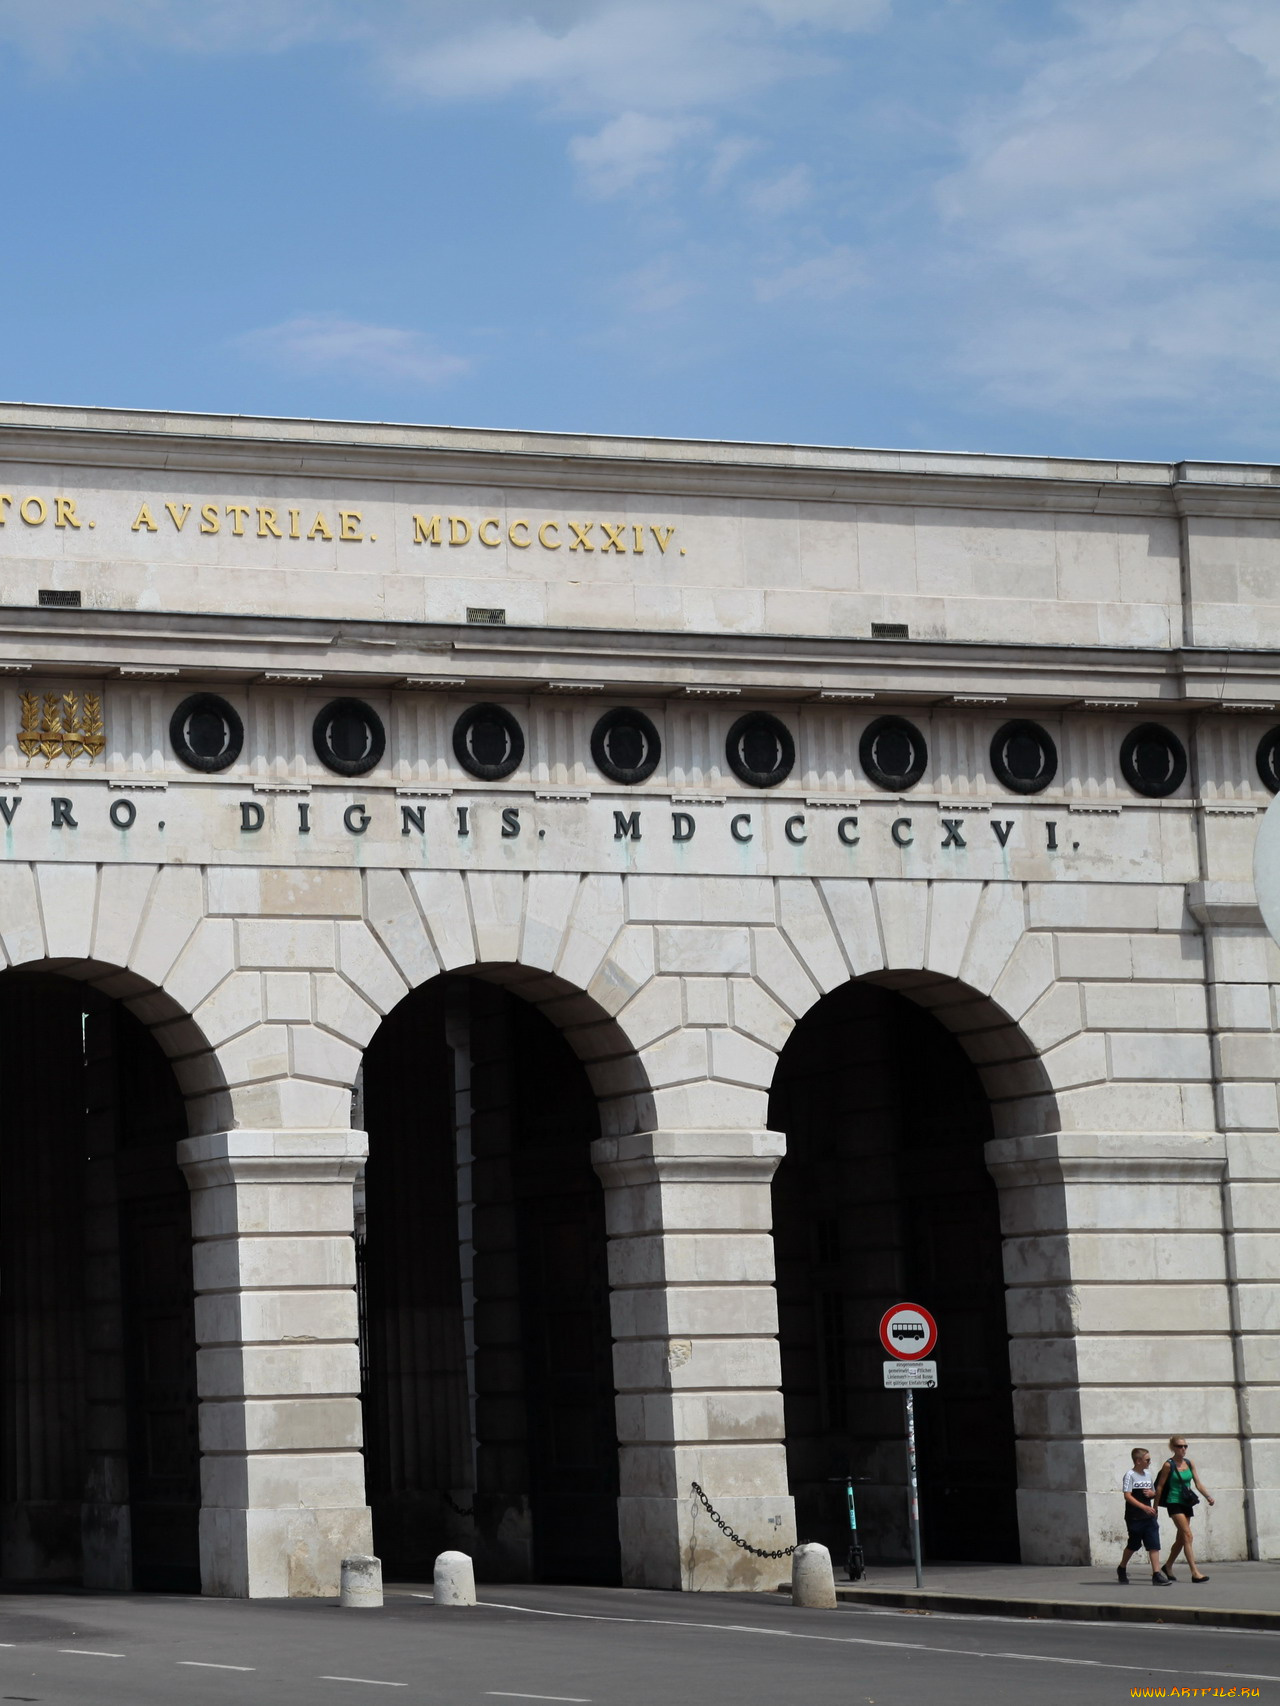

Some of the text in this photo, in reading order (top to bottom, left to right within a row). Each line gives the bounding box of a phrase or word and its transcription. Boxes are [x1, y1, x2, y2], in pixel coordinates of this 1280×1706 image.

[131, 502, 378, 541] AVSTRIAE.
[412, 513, 686, 554] MDCCCXXIV.
[239, 802, 546, 838] DIGNIS.
[613, 810, 1080, 850] MDCCCCXVI.
